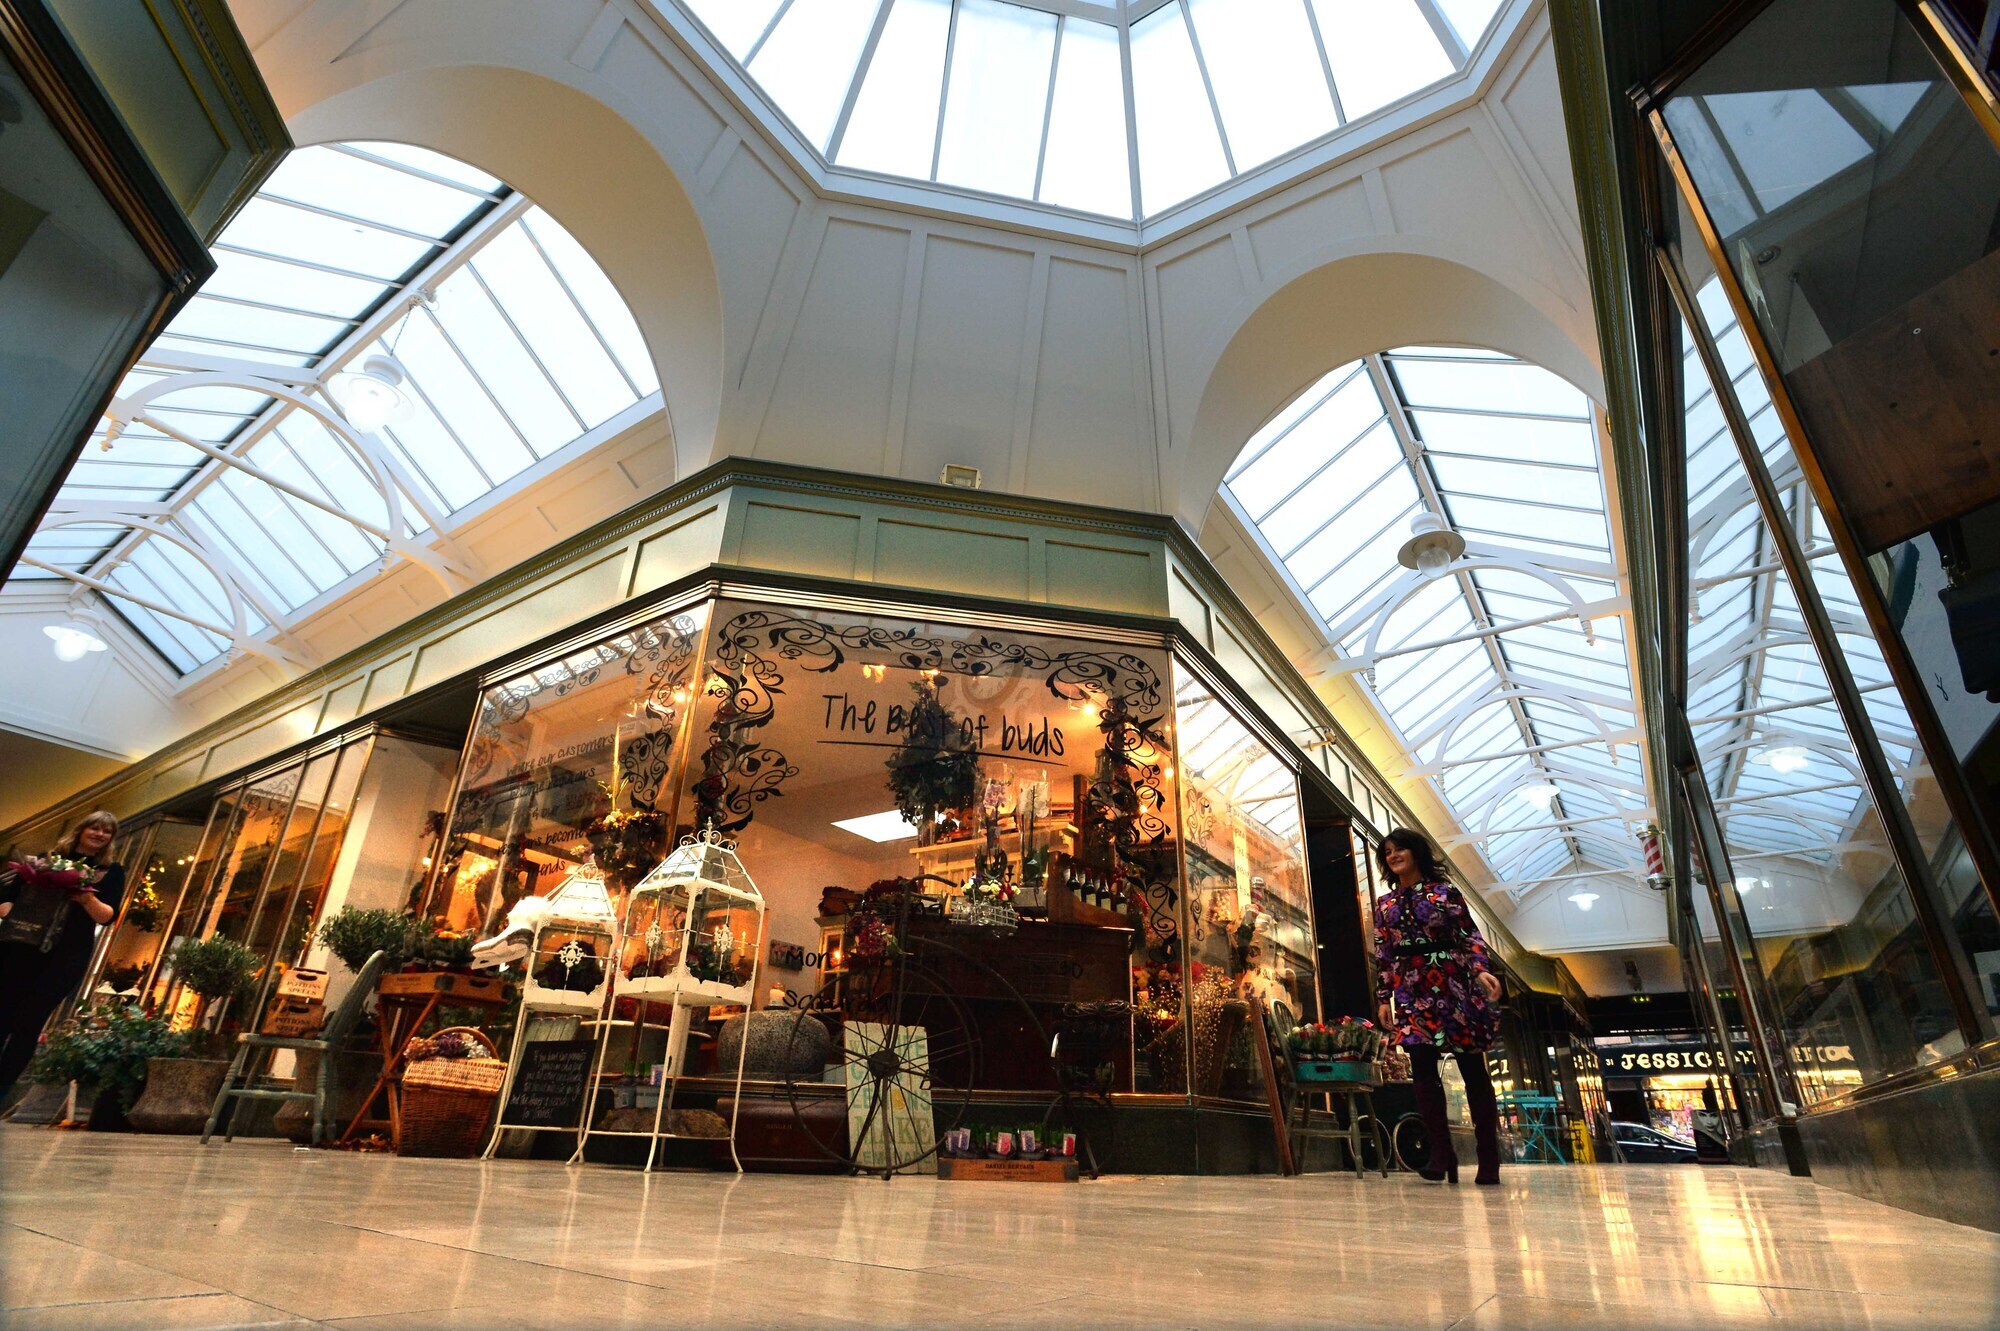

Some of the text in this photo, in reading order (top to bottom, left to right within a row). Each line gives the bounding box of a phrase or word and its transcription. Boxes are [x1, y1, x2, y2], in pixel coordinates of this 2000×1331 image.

[822, 693, 876, 733] The
[960, 714, 989, 749] of
[1002, 714, 1065, 757] buds
